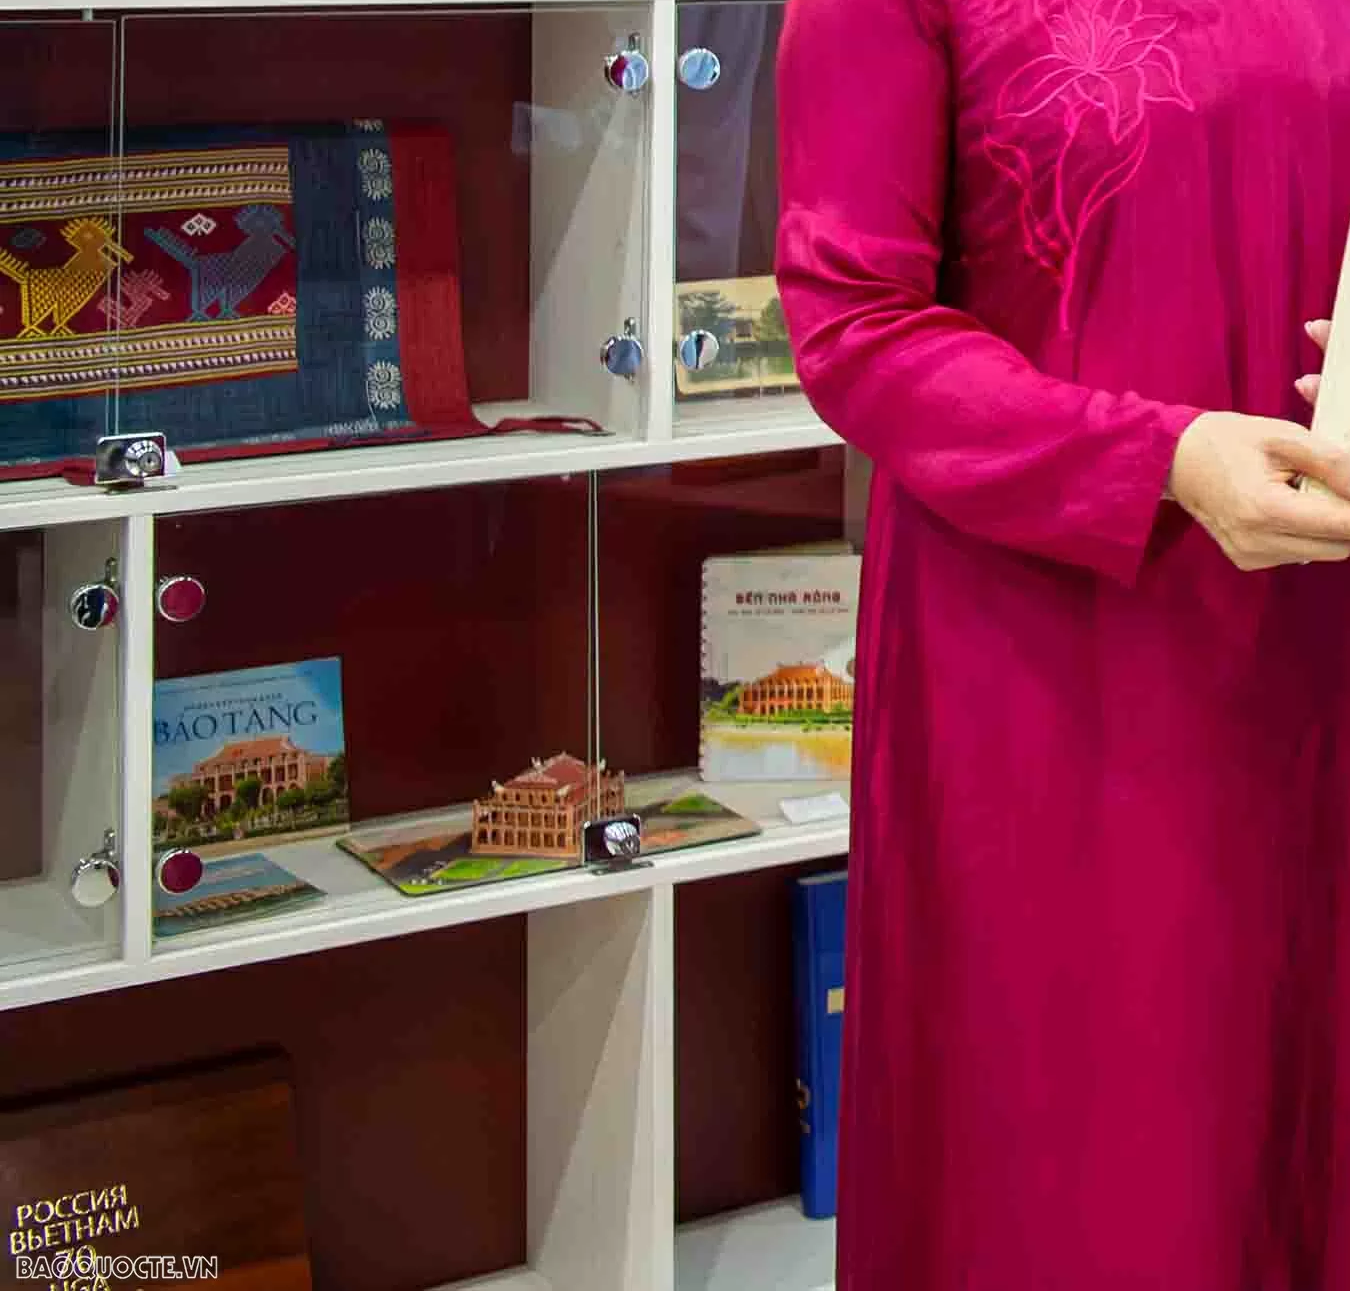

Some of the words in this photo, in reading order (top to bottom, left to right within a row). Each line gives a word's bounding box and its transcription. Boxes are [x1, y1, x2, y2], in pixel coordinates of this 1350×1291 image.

[15, 1184, 128, 1228] РОССИЯ
[9, 1205, 140, 1255] ВЬЕТНАМ
[55, 1244, 97, 1277] 70
